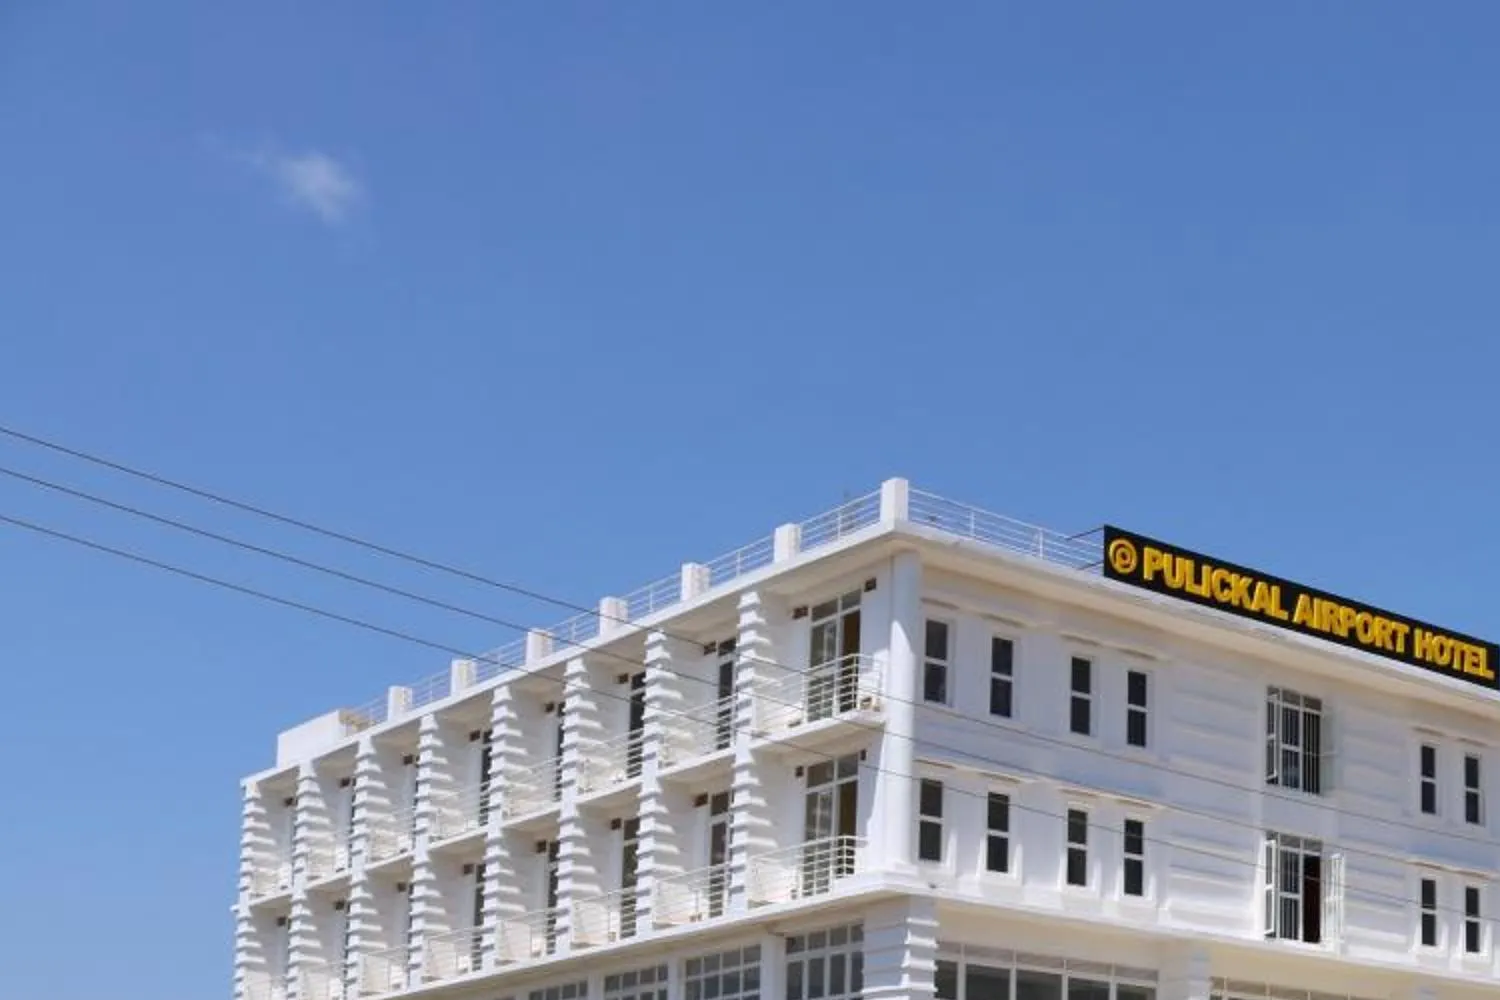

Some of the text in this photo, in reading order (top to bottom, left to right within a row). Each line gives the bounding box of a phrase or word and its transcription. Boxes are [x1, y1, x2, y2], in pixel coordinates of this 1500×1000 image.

[1143, 547, 1289, 621] PULICKAL
[1293, 593, 1409, 653] AIRPORT
[1414, 628, 1494, 679] HOTEL
